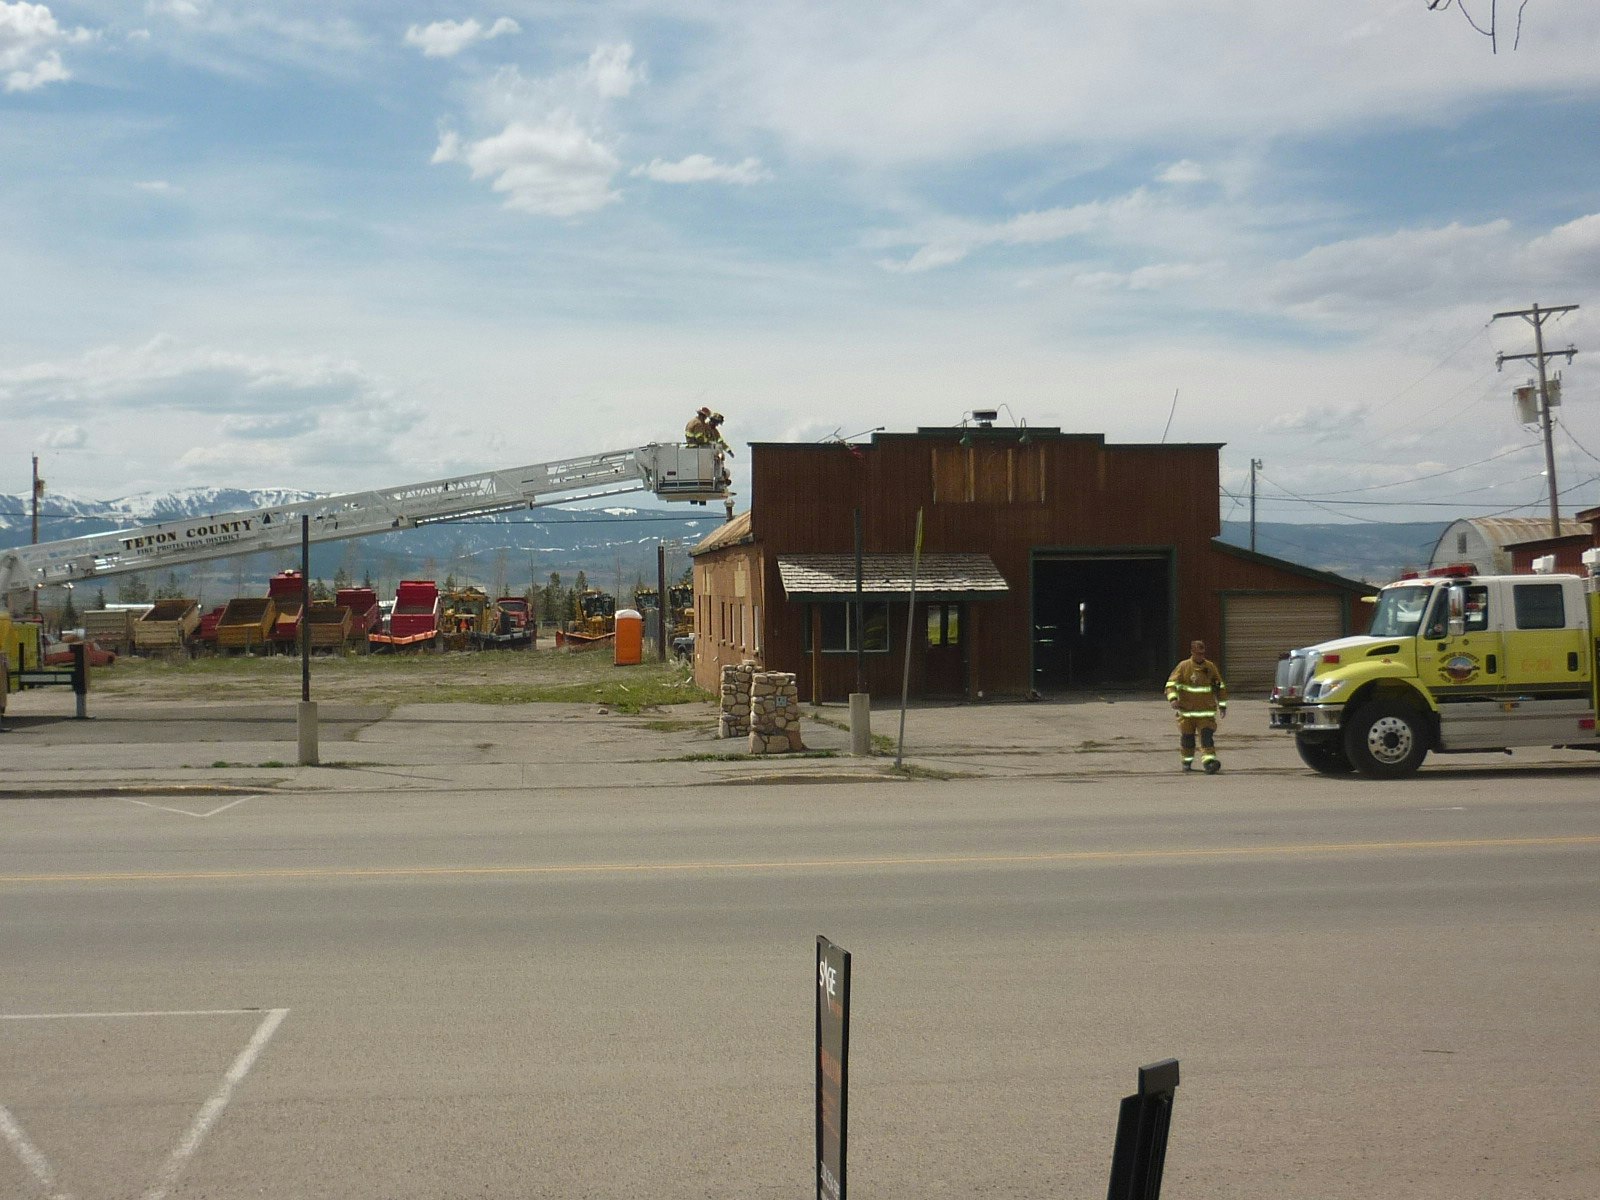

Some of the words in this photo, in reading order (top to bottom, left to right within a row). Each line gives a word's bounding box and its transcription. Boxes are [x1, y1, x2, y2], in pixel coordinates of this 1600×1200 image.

[123, 531, 177, 551] TETON
[186, 519, 252, 538] COUNTY
[136, 548, 154, 556] FIRE
[157, 539, 204, 554] PROTECTION
[205, 533, 241, 545] DISTRICT
